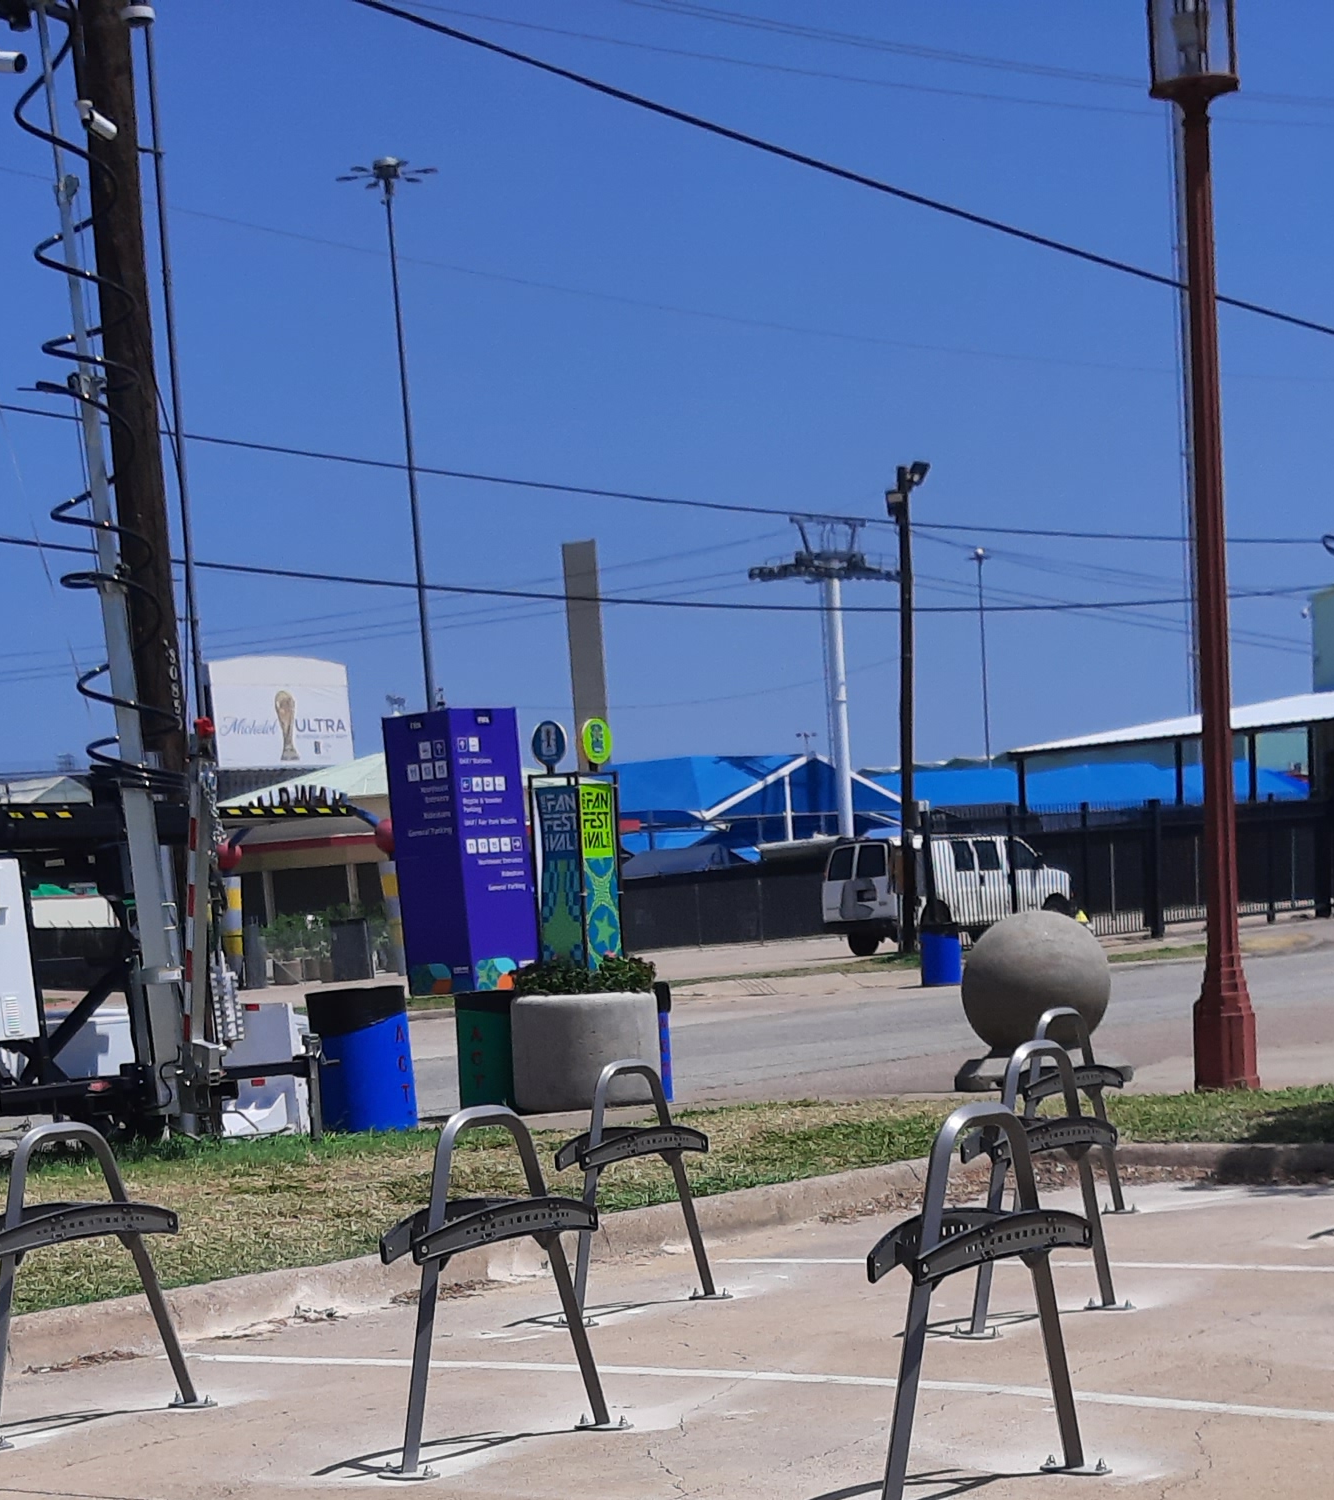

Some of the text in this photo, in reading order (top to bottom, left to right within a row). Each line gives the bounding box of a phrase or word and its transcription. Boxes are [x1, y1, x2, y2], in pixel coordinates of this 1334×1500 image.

[220, 717, 346, 736] Michelob ULTRA
[546, 793, 577, 813] FAN
[585, 791, 609, 811] FAN
[543, 813, 577, 832] FEST
[582, 811, 609, 830] FEST
